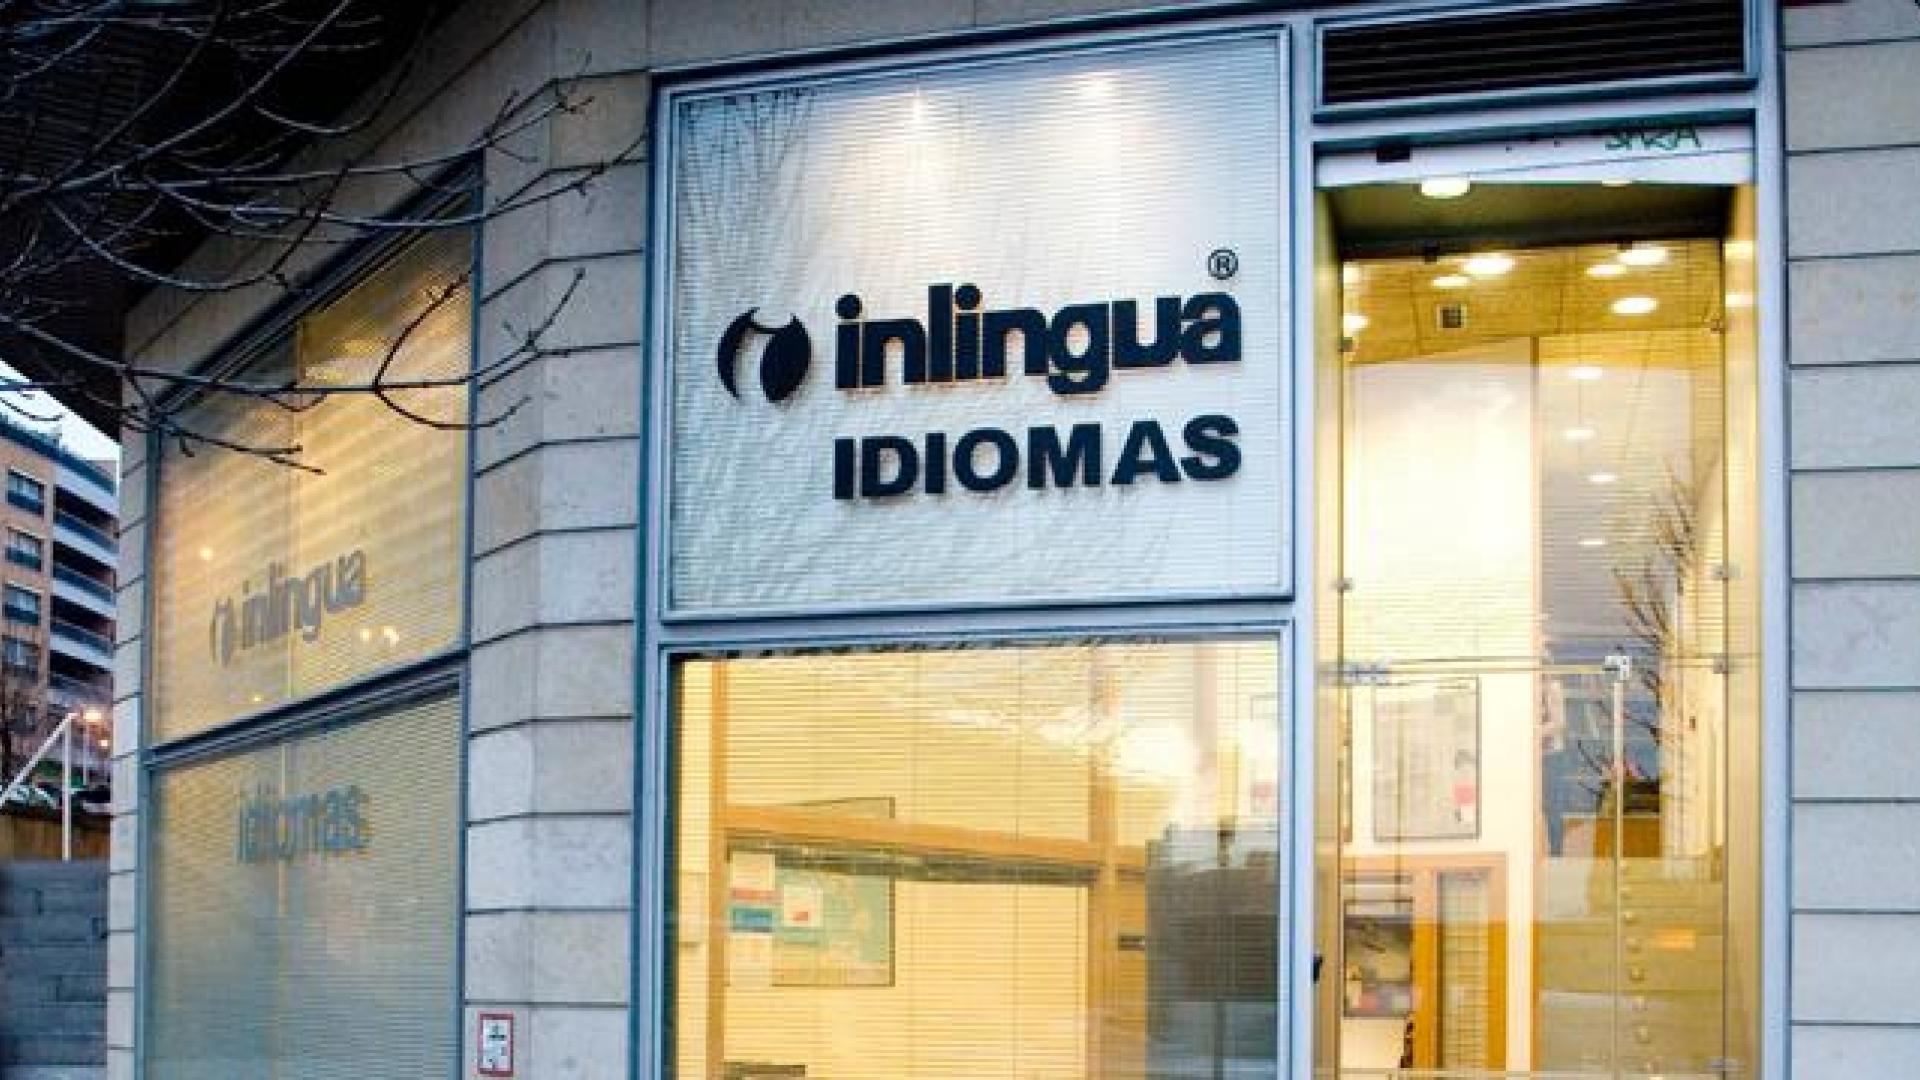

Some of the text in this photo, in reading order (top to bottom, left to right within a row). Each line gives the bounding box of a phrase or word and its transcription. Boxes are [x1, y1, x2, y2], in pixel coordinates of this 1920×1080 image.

[836, 283, 1241, 394] inlingua
[833, 414, 1241, 499] IDIOMAS
[241, 550, 366, 650] inlingua
[238, 780, 369, 863] idiomas
